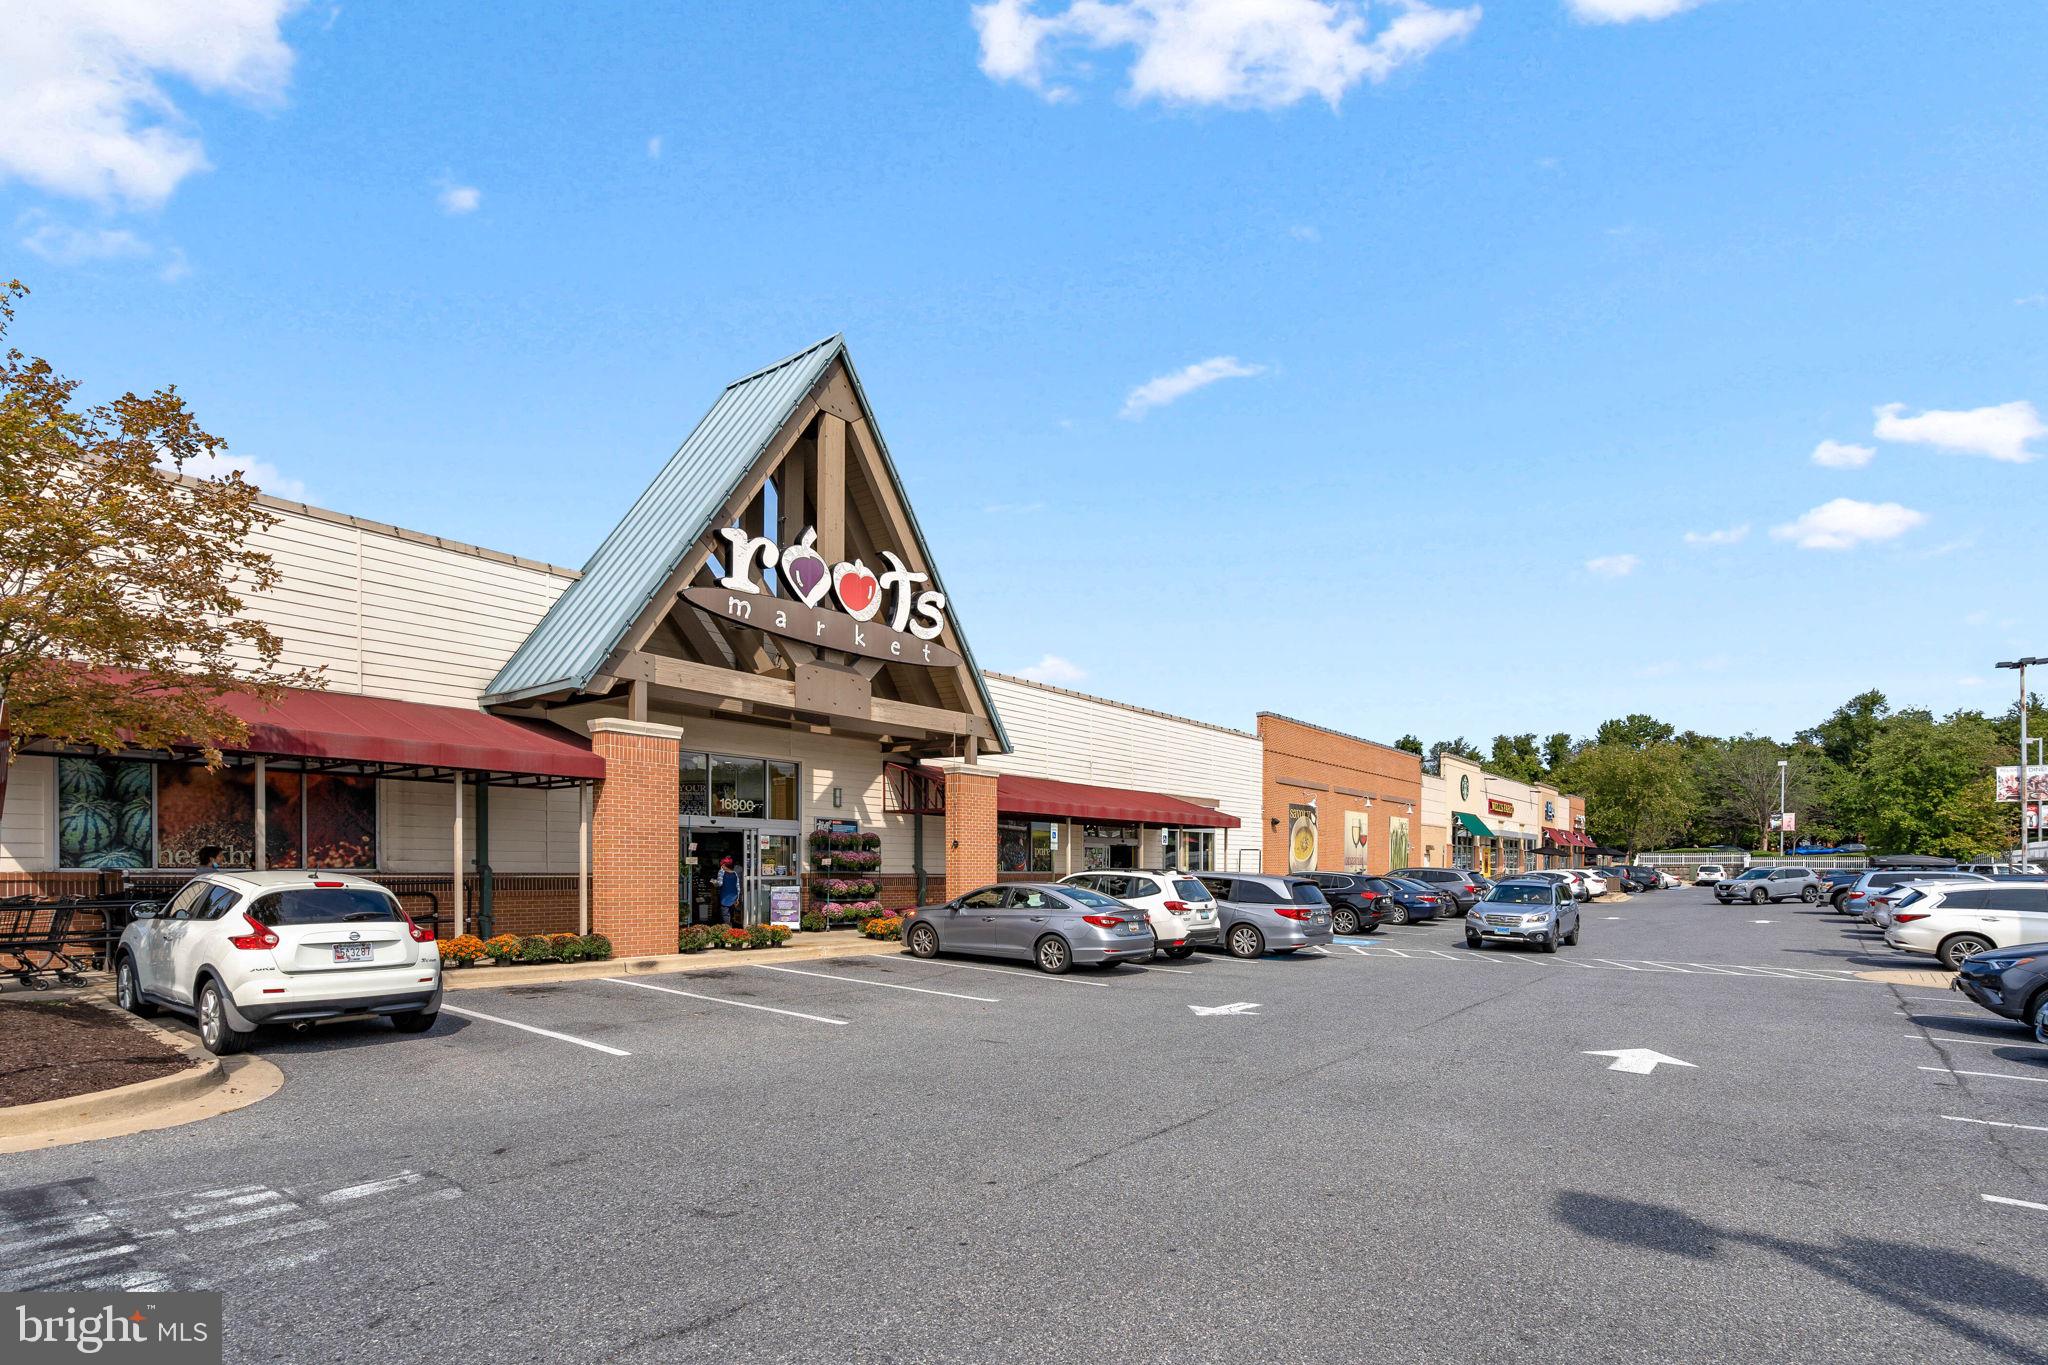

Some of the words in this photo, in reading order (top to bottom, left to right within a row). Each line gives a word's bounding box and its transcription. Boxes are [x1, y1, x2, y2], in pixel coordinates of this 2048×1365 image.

[716, 525, 945, 640] roots
[728, 595, 931, 663] market
[720, 798, 754, 811] 16800
